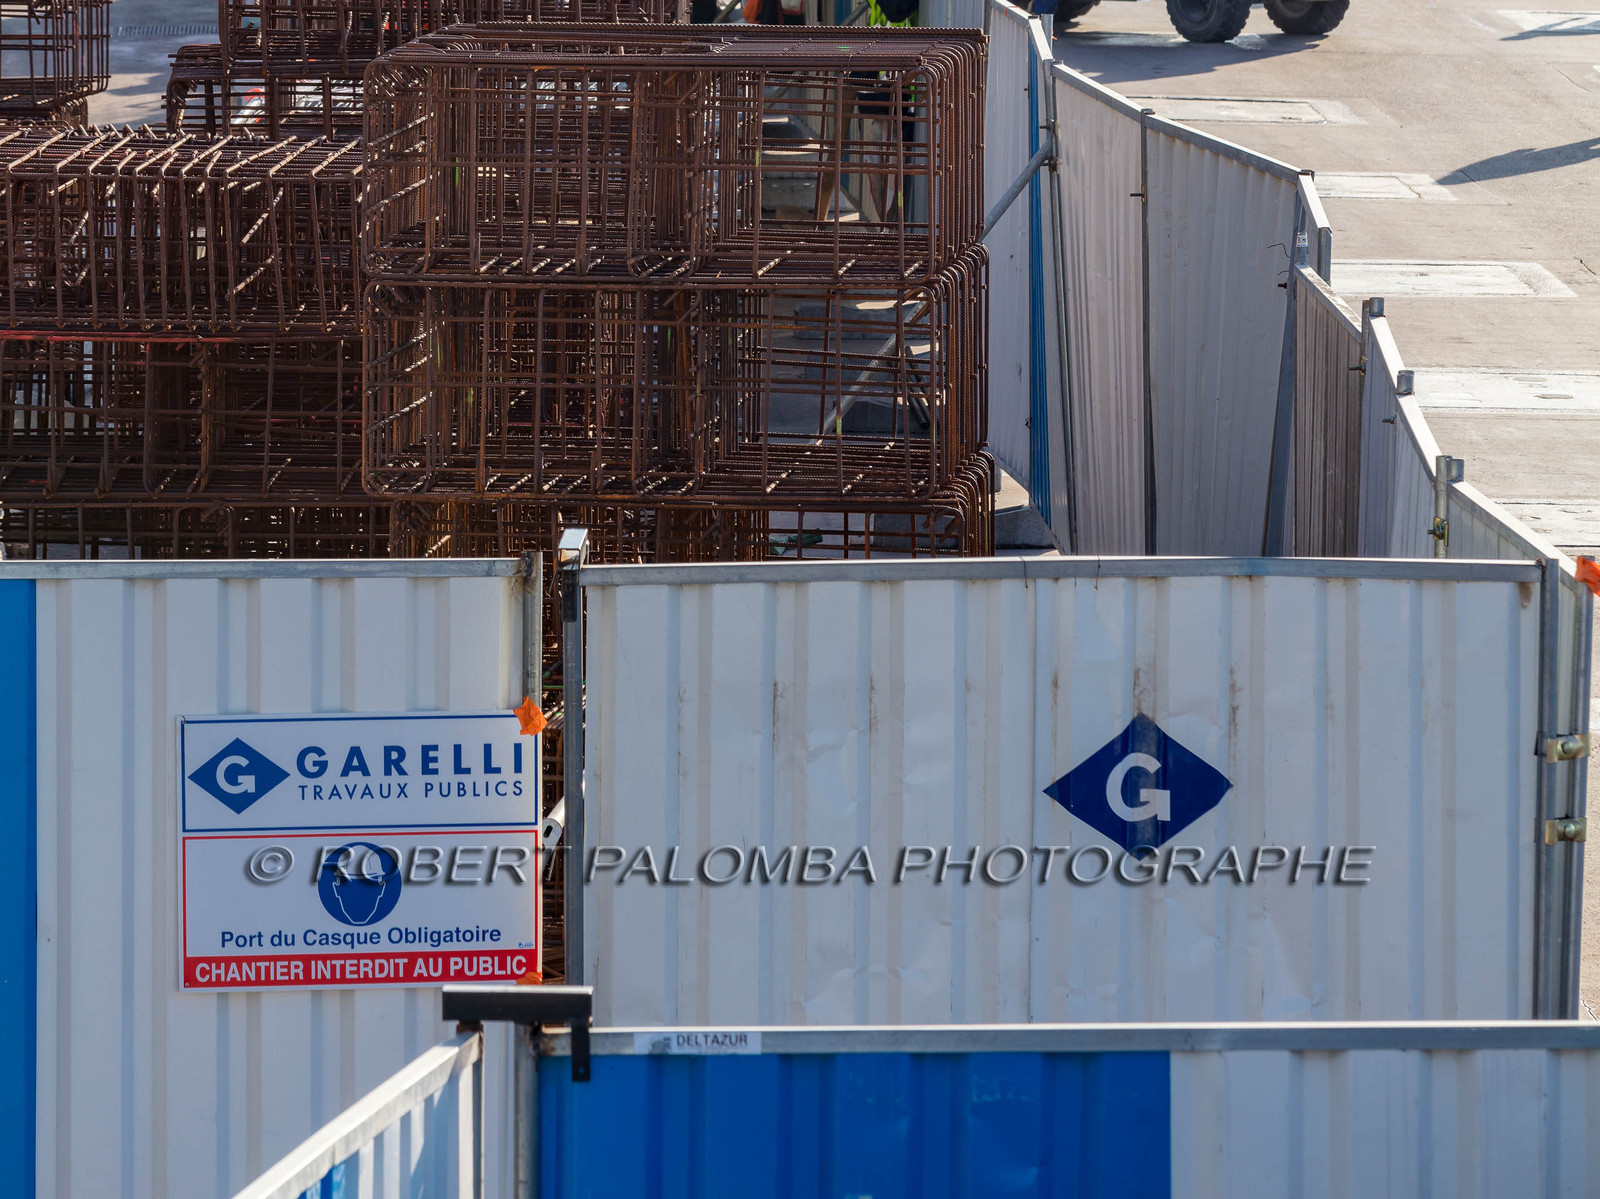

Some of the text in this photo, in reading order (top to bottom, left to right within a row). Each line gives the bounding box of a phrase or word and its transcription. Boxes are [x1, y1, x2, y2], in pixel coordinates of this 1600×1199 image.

[216, 755, 256, 795] G
[296, 743, 523, 779] GARELLI
[298, 780, 523, 801] TRAVAUX PUBLICS
[1105, 752, 1171, 822] G
[221, 925, 502, 949] Port du Casque Obligatoire
[195, 955, 527, 983] CHANTIER INTERDIT AU PUBLIC
[676, 1033, 749, 1048] DELTAZUR
